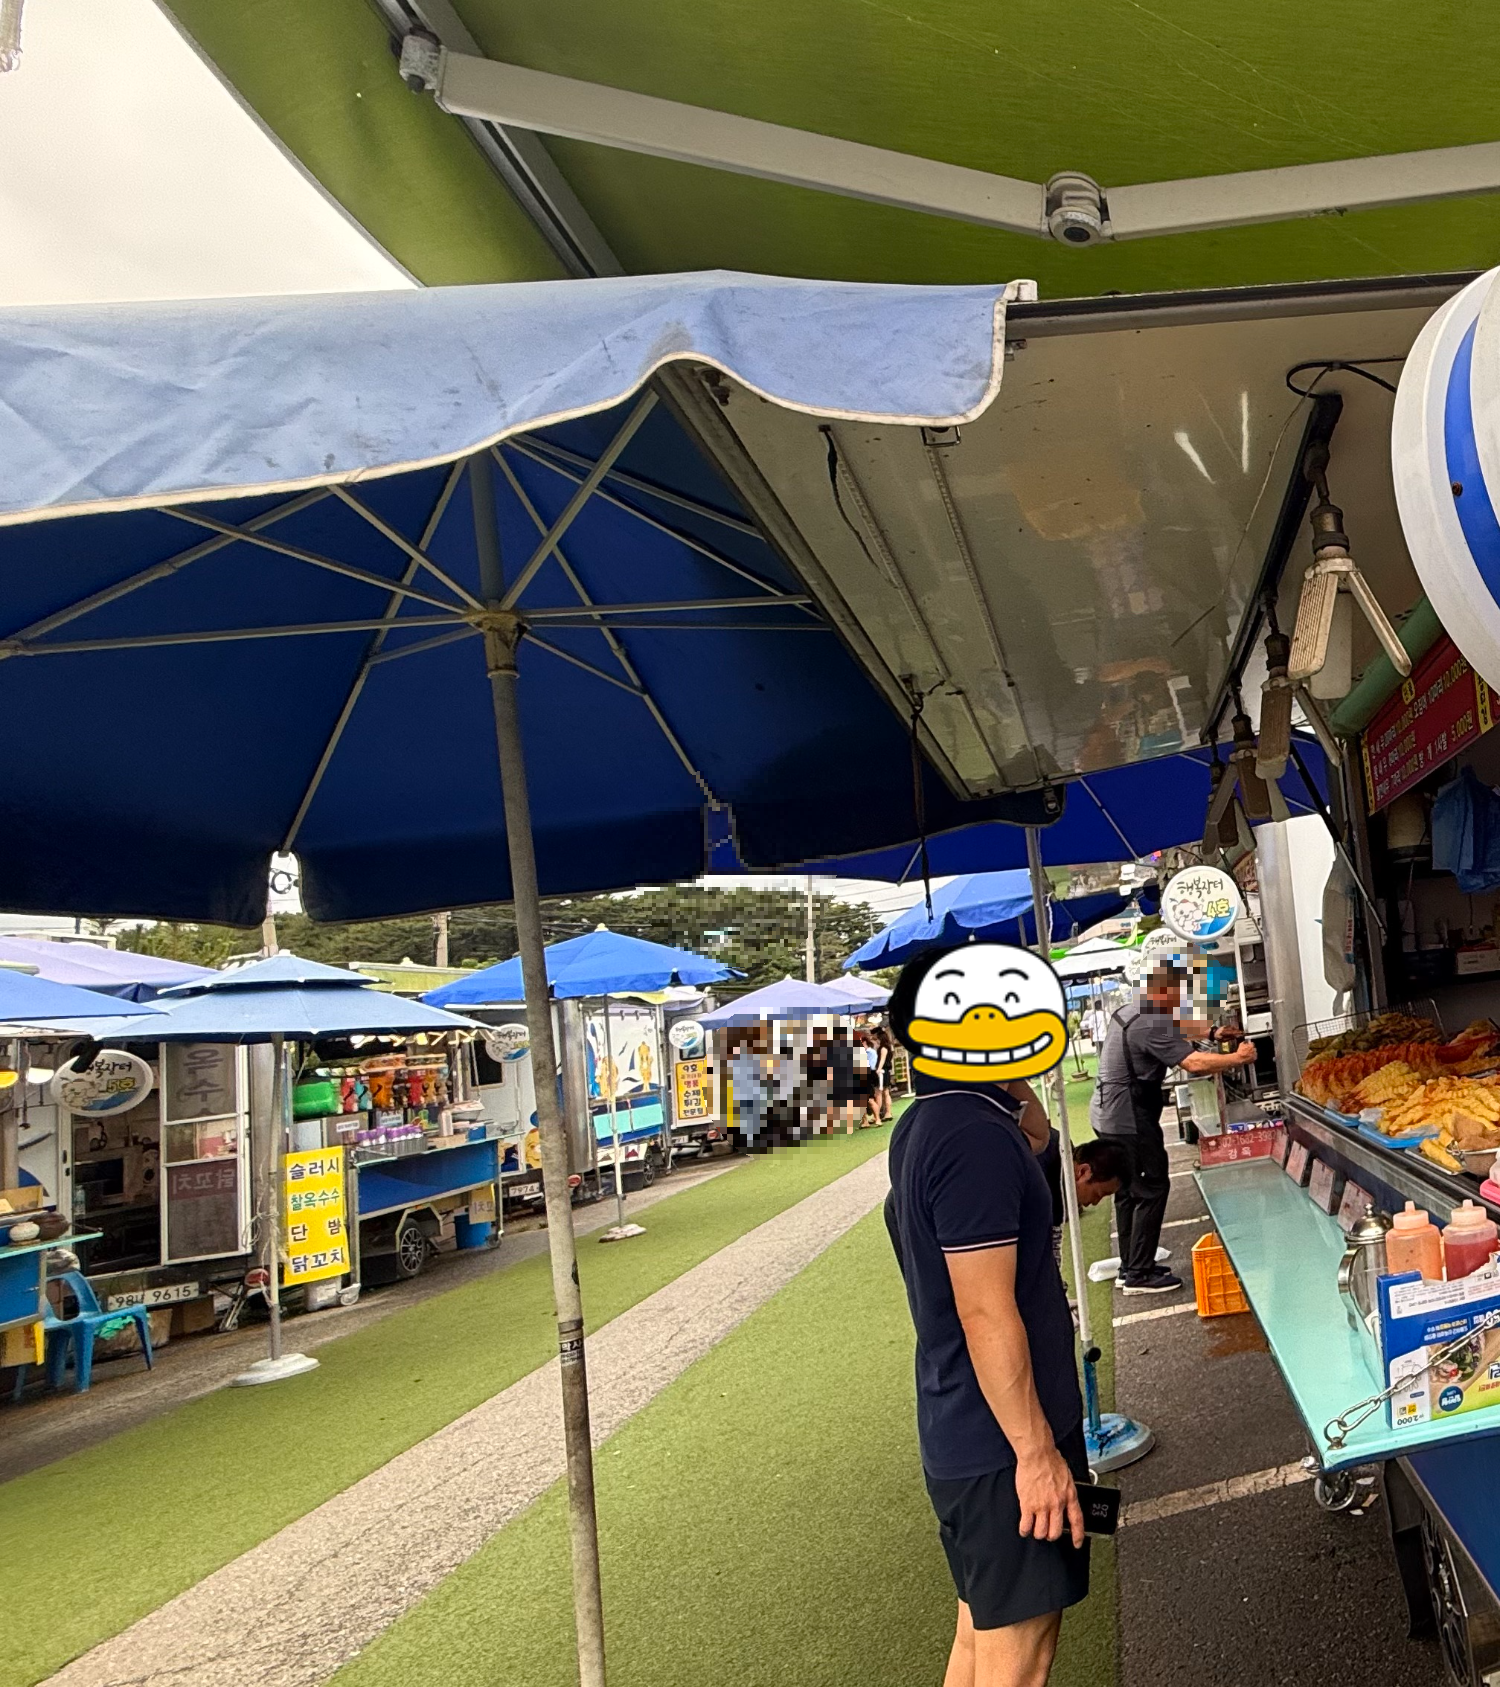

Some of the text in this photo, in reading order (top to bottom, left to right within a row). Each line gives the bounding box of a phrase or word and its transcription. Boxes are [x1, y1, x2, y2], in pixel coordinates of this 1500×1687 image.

[1177, 876, 1224, 899] 행복장터
[289, 1157, 339, 1180] 슬러시
[291, 1188, 340, 1211] 찰옥수수
[291, 1218, 342, 1242] 단 밤
[292, 1247, 344, 1273] 닭꼬치
[153, 1285, 191, 1302] 9615
